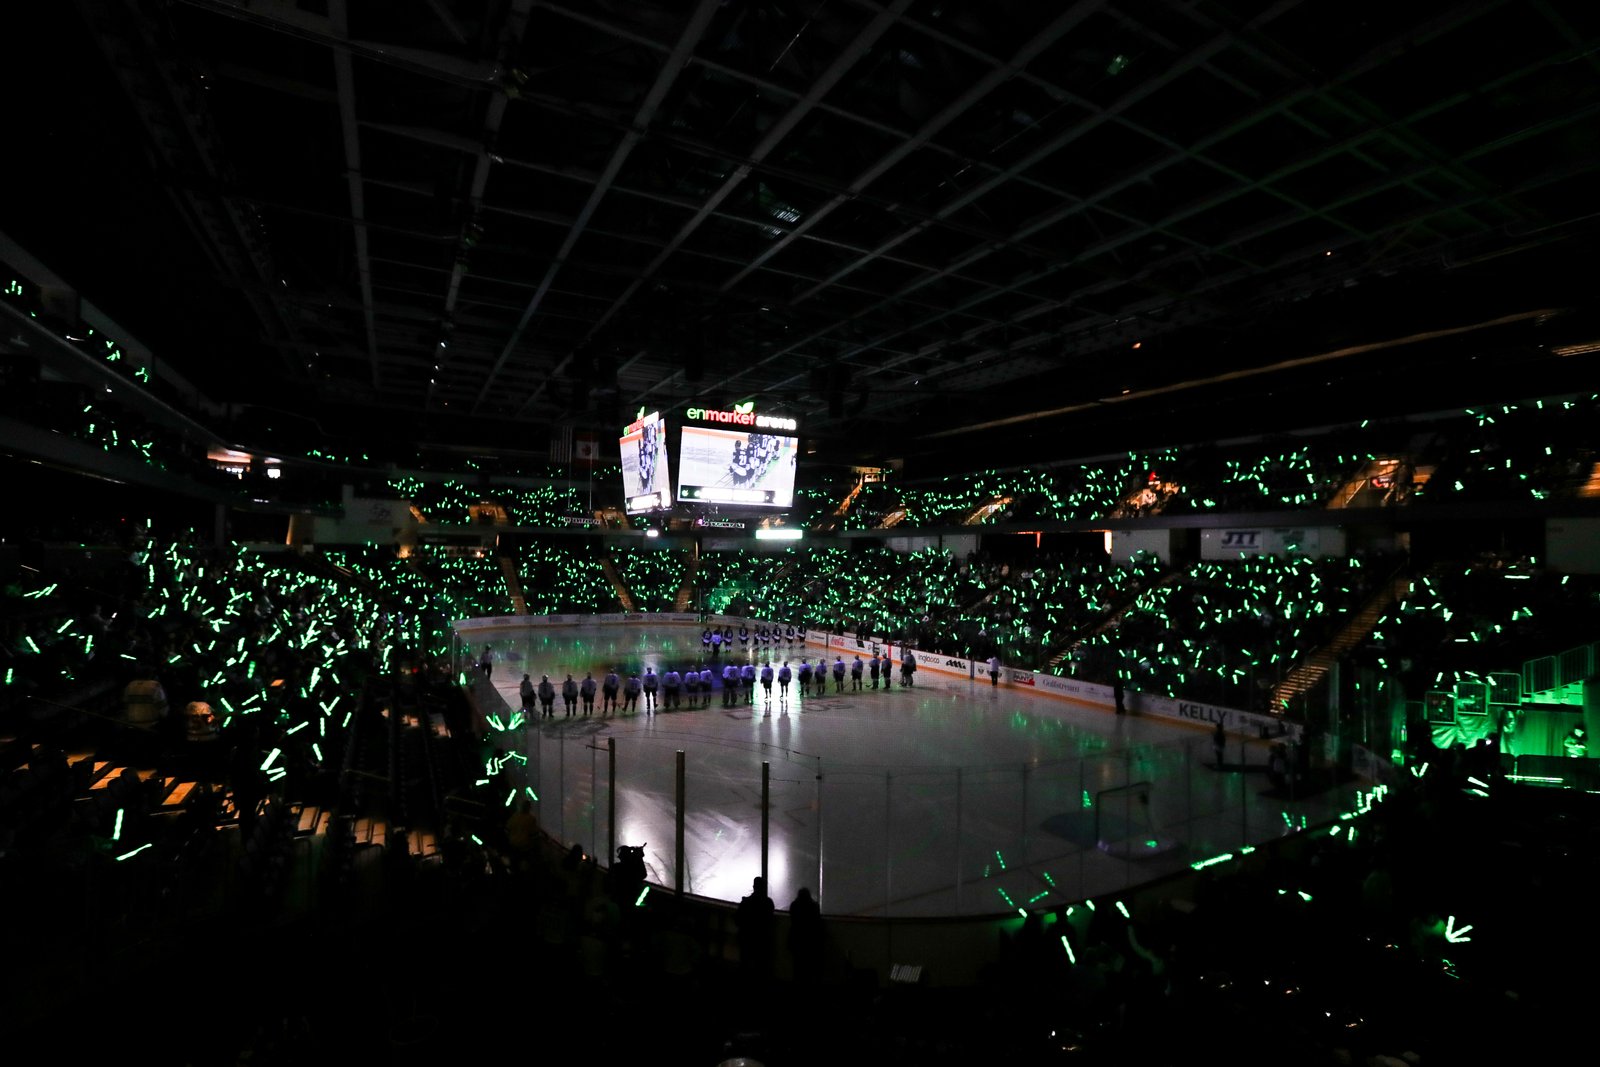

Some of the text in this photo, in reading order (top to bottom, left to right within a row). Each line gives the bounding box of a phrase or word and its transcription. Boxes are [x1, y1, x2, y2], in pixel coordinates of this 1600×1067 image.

[686, 407, 797, 431] enmarket arena
[1179, 703, 1227, 724] KELLY
